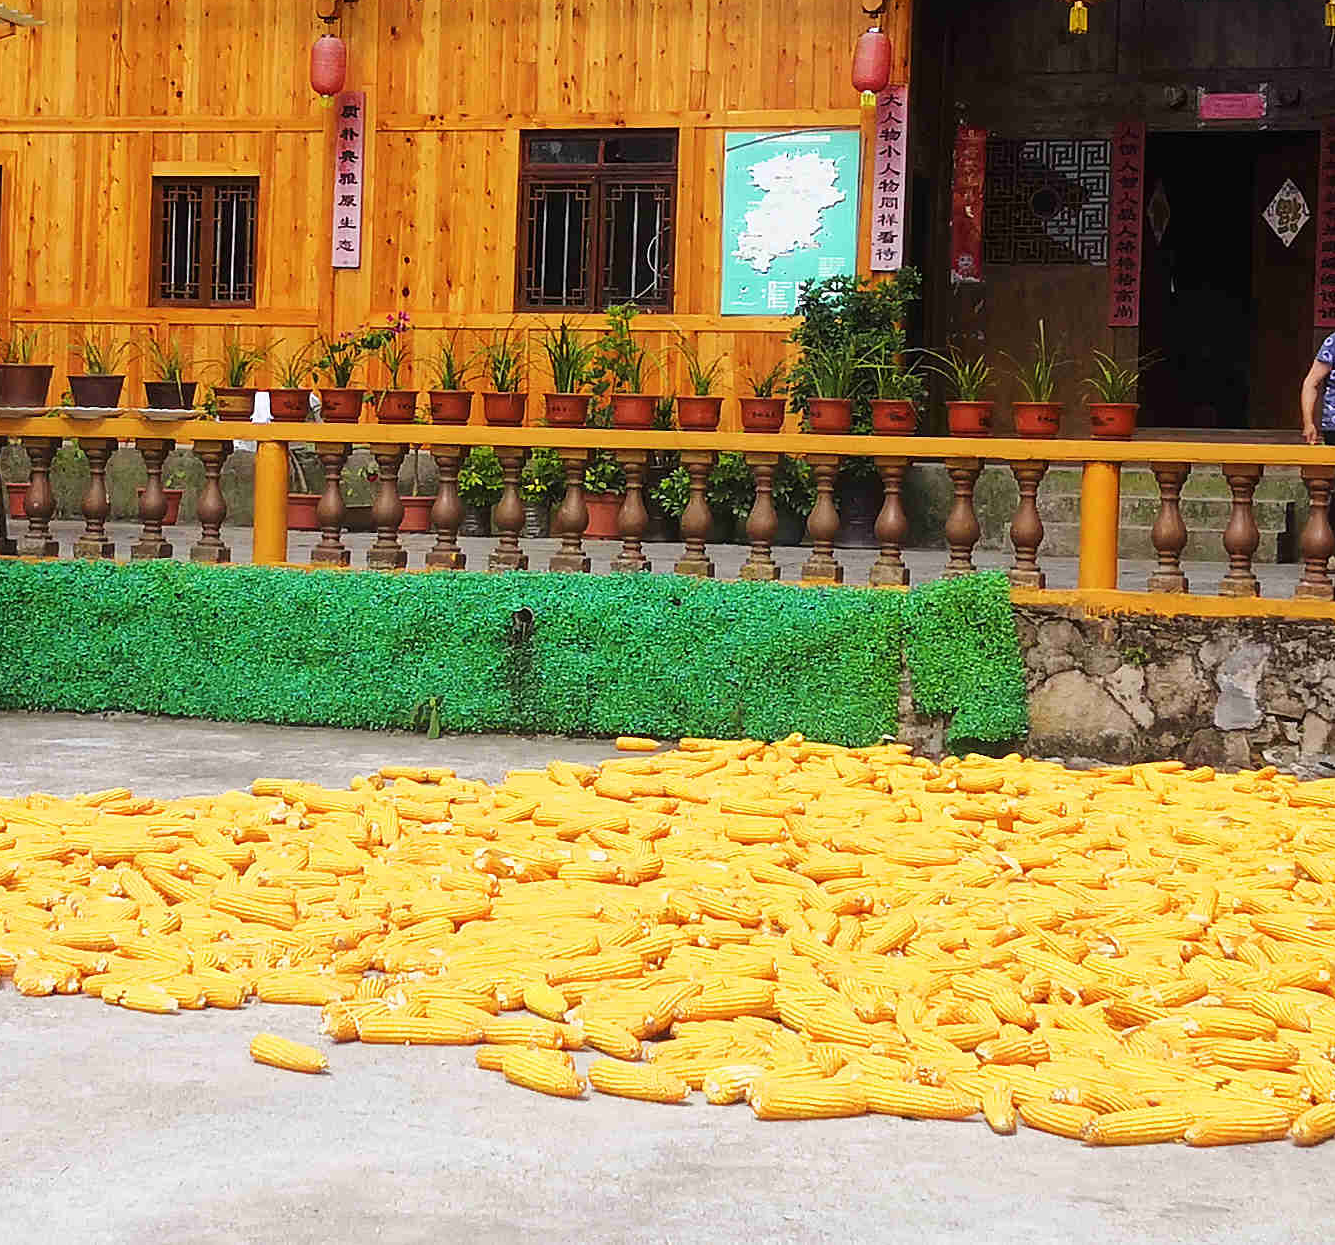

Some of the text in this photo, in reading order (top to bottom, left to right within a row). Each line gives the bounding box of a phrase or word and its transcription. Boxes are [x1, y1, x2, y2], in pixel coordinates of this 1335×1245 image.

[336, 105, 361, 252] 质朴典雅原生态
[875, 92, 903, 262] 大人物小人物同样看待
